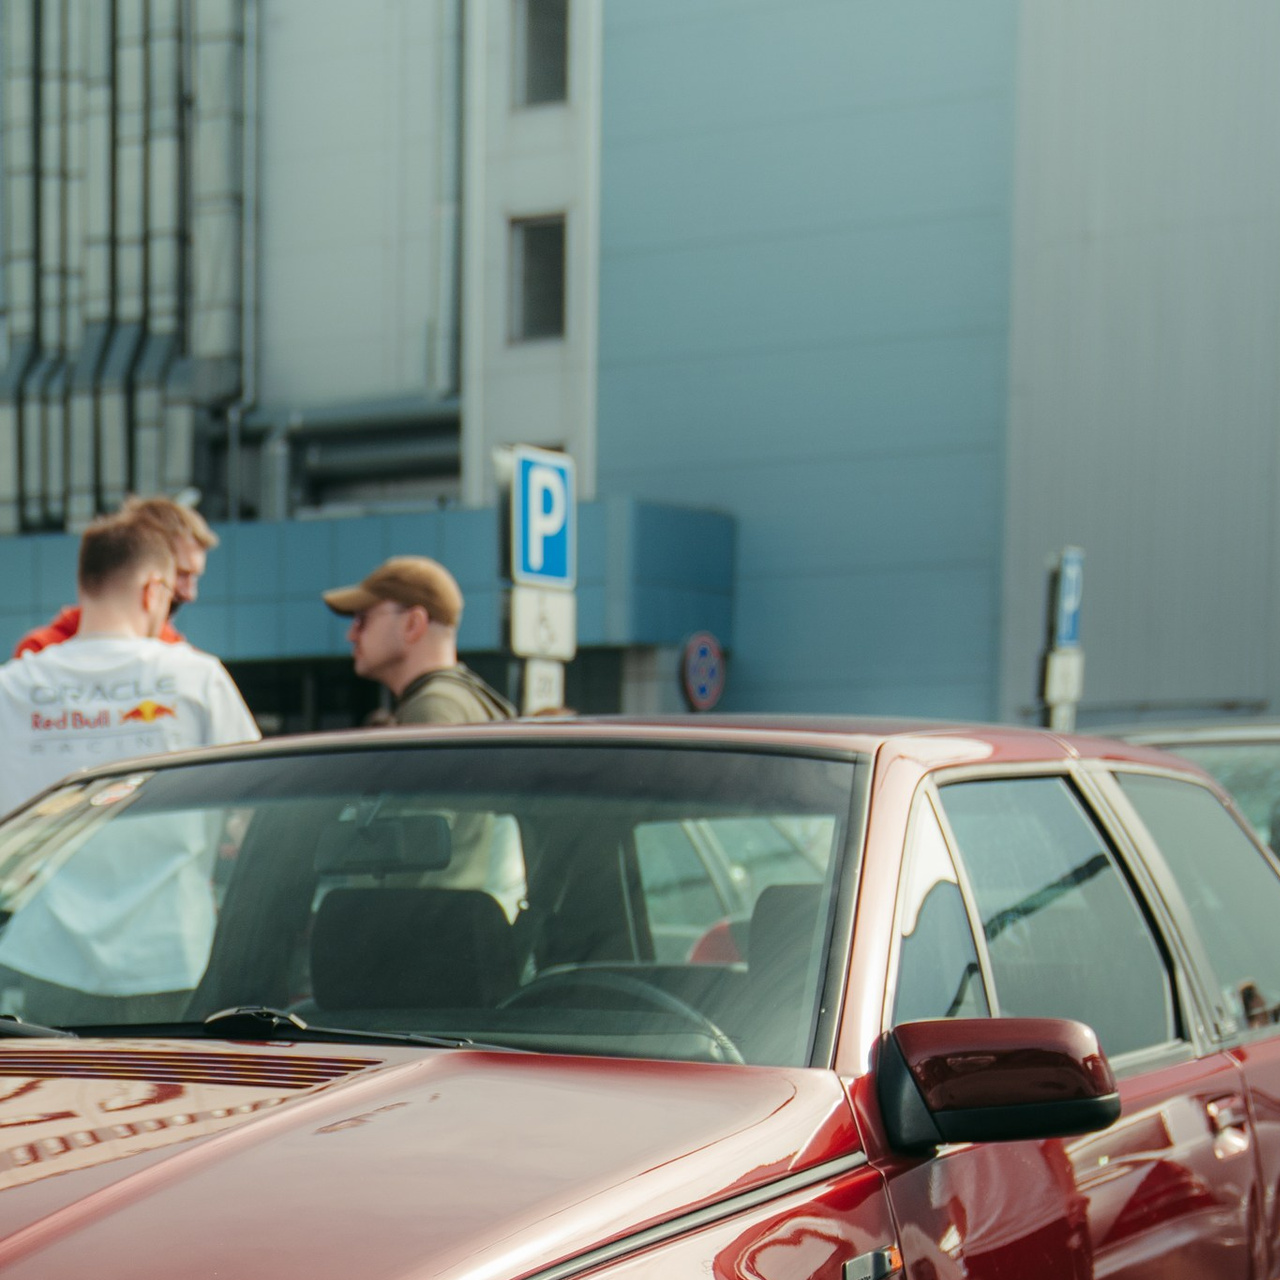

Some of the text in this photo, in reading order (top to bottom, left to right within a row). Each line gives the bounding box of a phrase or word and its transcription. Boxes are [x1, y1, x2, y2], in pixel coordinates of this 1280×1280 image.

[528, 464, 566, 571] P
[30, 675, 178, 706] ORACLE
[31, 708, 110, 730] Red Bull
